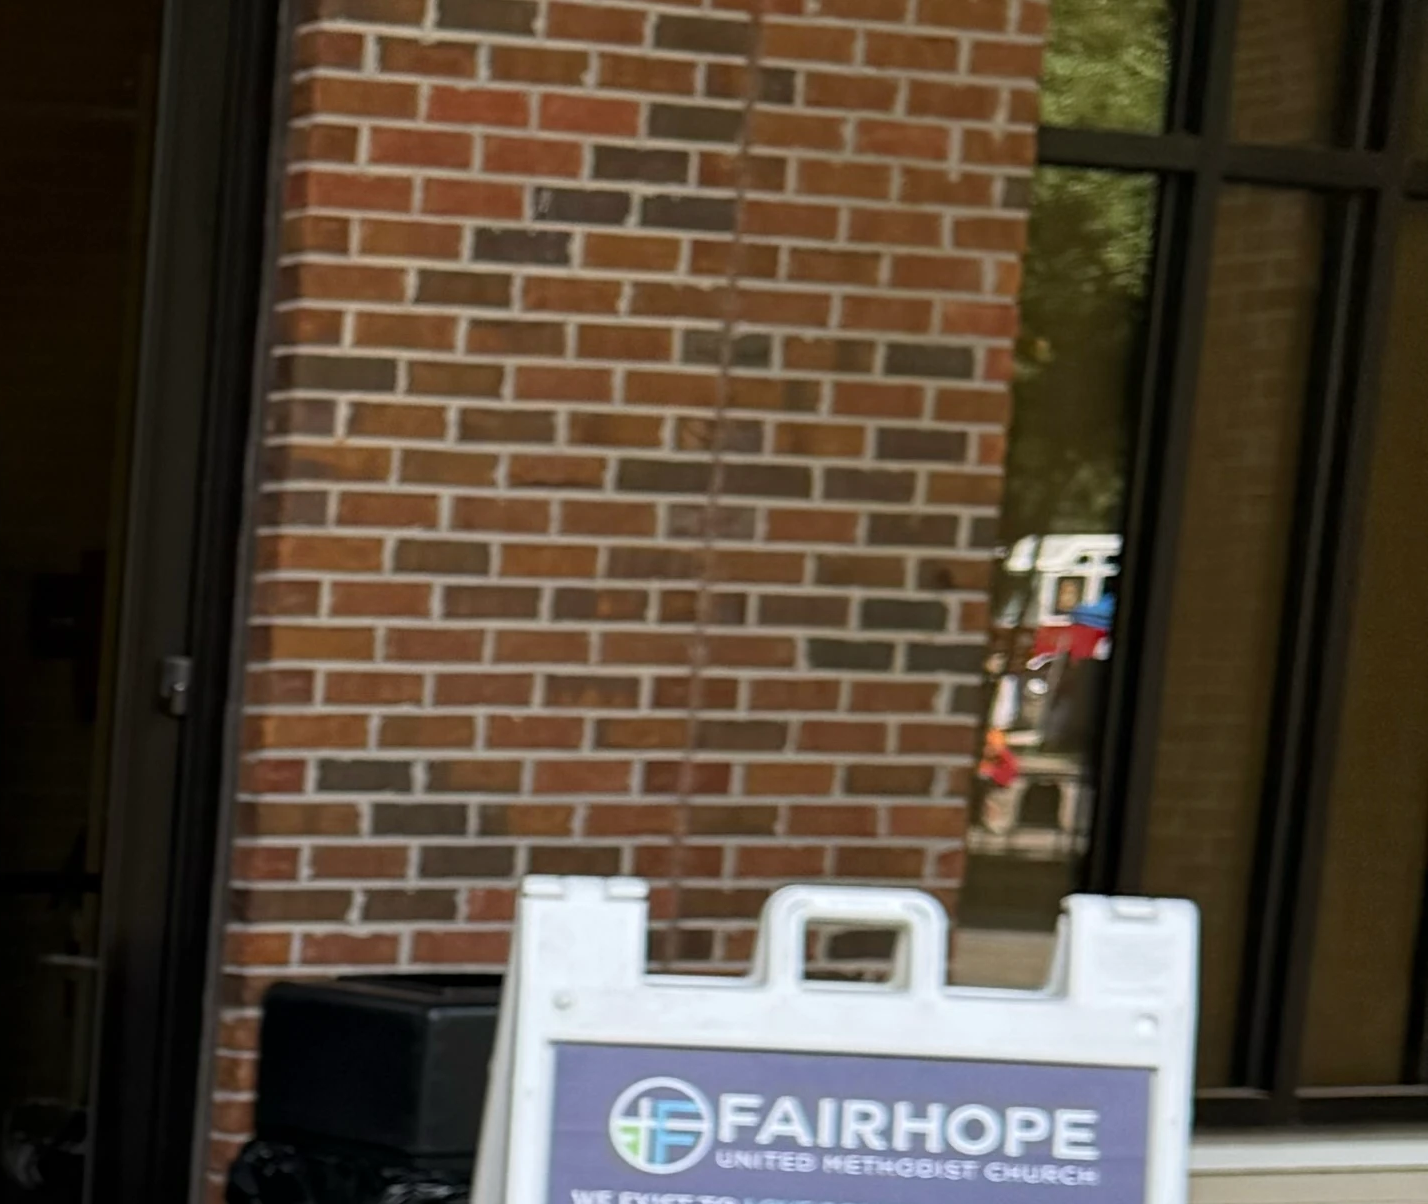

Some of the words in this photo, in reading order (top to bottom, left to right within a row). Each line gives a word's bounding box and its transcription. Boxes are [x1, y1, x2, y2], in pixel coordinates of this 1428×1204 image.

[716, 1092, 1102, 1161] FAIRHOPE
[714, 1149, 818, 1173] UNITED
[821, 1153, 981, 1182] METHODIST
[983, 1161, 1102, 1187] CHURCH
